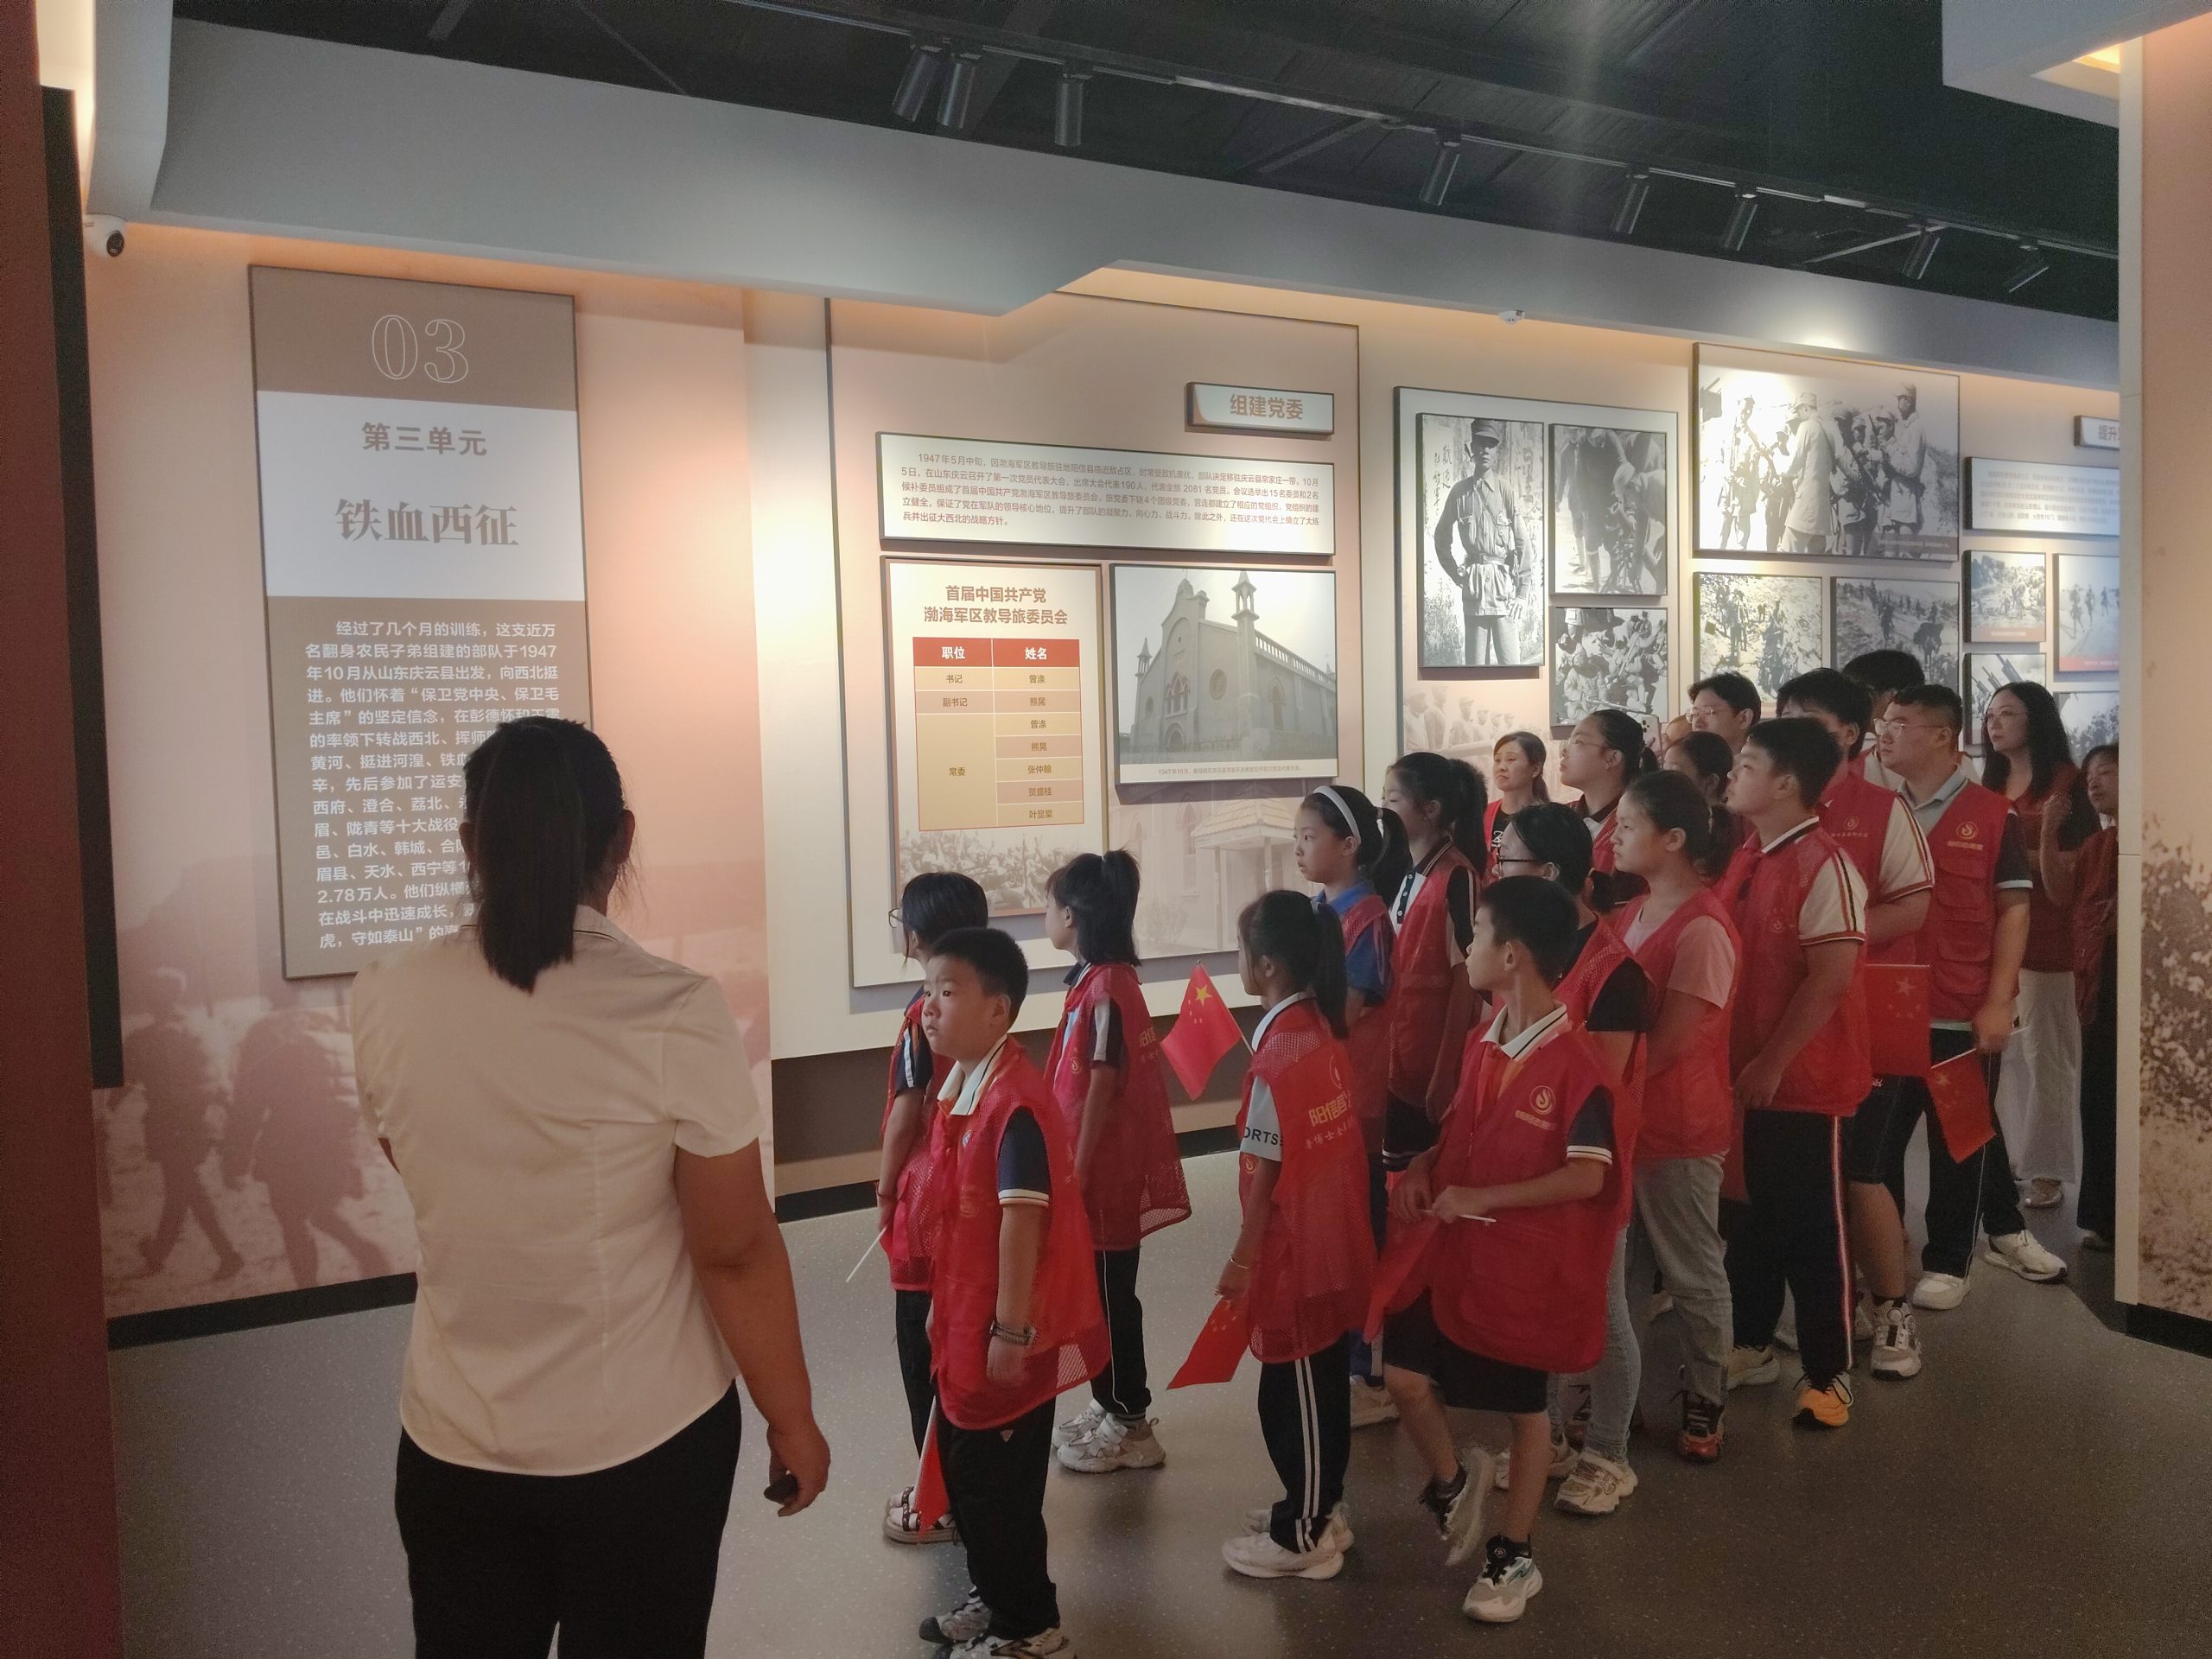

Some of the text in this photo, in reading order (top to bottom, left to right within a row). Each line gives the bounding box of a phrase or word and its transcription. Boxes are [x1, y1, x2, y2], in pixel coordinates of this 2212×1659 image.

[372, 315, 468, 384] 03
[1230, 394, 1303, 420] 组建党委
[361, 422, 487, 456] 第三单元
[2098, 424, 2120, 441] 提升
[335, 499, 519, 546] 铁血西征
[945, 585, 1046, 604] 首届中国共产党
[924, 607, 1068, 625] 渤海军区教导旅委员会
[305, 644, 557, 658] 名翻身农民子弟组建的部队于1947
[941, 646, 965, 660] 职位
[1025, 647, 1047, 660] 姓名
[945, 674, 963, 683] 书记
[943, 697, 968, 707] 副书记
[949, 766, 965, 777] 常委
